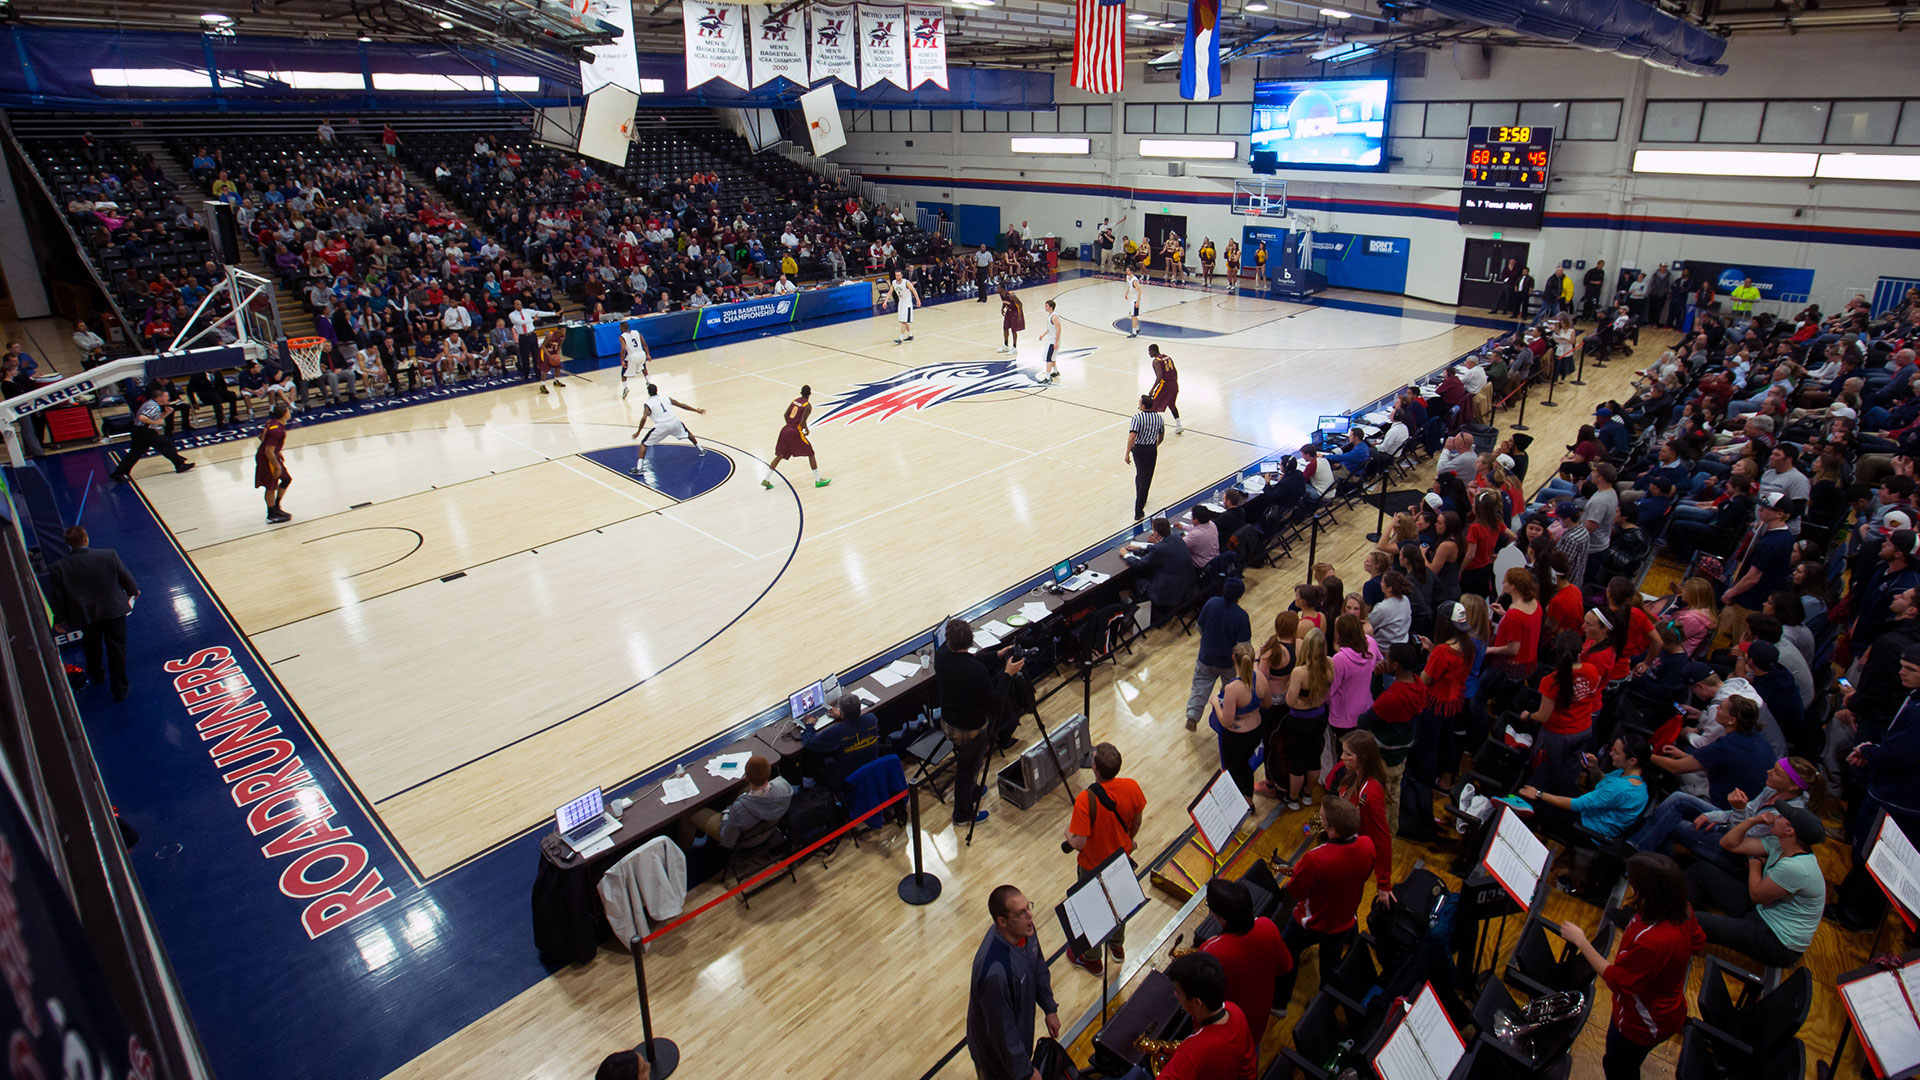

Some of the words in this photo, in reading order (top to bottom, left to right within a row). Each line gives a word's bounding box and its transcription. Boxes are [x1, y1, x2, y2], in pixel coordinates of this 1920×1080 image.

[812, 6, 834, 17] METRO
[861, 11, 883, 19] METRO
[909, 9, 927, 17] METRO
[696, 46, 736, 54] BASKETBALL
[1499, 126, 1530, 142] 3:58
[1471, 149, 1490, 165] 68
[1501, 151, 1511, 165] 2
[1527, 151, 1547, 167] 45
[1470, 168, 1478, 180] 7
[1537, 170, 1545, 183] 7
[1369, 240, 1394, 248] DON'T
[723, 310, 737, 318] 2014
[738, 304, 776, 314] BASKETBALL
[723, 310, 776, 324] CHAMPIONSHIP
[707, 317, 721, 325] NCAA
[631, 338, 639, 348] 3
[14, 380, 95, 415] GARED
[360, 393, 428, 411] STATE
[660, 402, 667, 413] 1
[790, 405, 799, 419] 0
[163, 644, 398, 941] ROADRUNNERS
